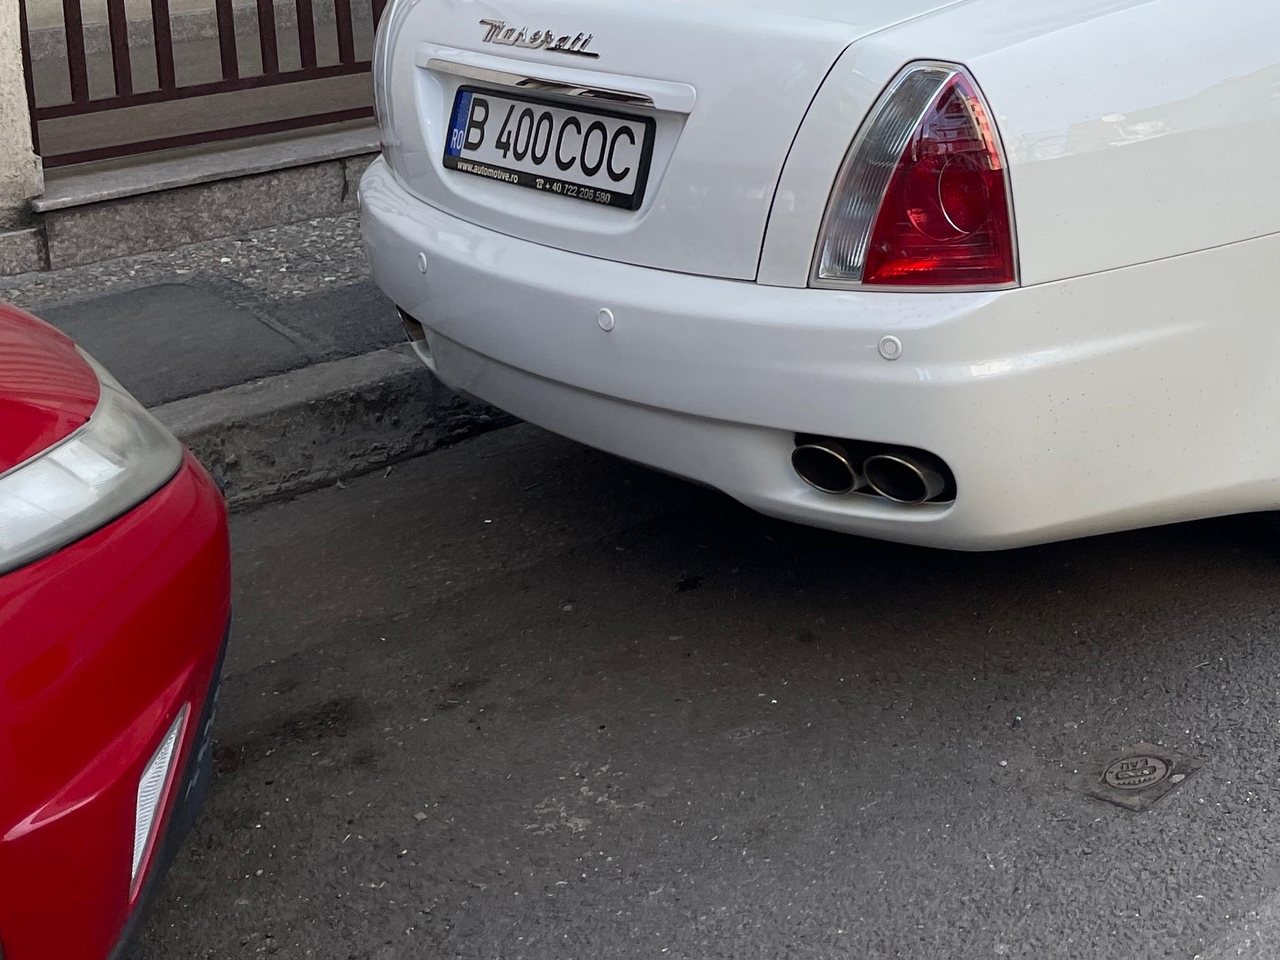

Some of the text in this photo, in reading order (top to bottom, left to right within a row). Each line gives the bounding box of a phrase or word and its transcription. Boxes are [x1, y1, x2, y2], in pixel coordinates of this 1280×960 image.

[479, 19, 600, 59] Maserati
[450, 128, 464, 150] RO
[463, 97, 490, 151] B
[457, 160, 519, 184] www.automotive.ro
